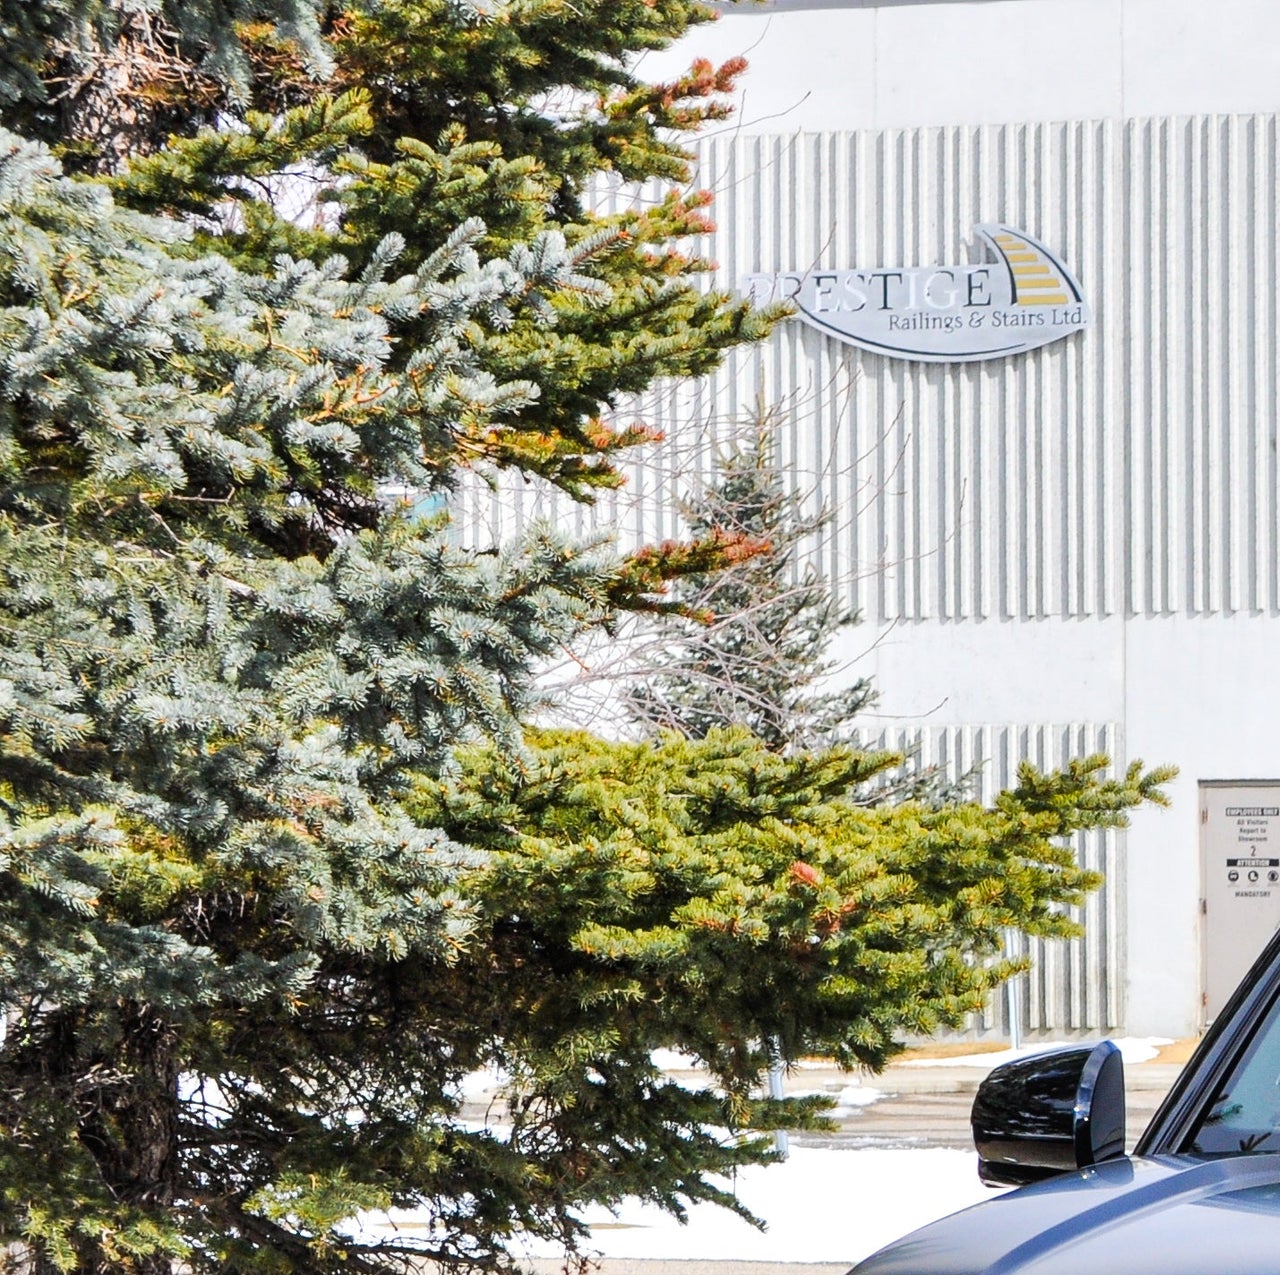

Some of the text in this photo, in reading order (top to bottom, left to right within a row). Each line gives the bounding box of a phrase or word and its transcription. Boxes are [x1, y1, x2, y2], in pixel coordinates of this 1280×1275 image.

[747, 268, 992, 313] PRESTIGE
[889, 307, 1088, 333] Railings & Stairs Ltd.
[1250, 845, 1256, 857] 2
